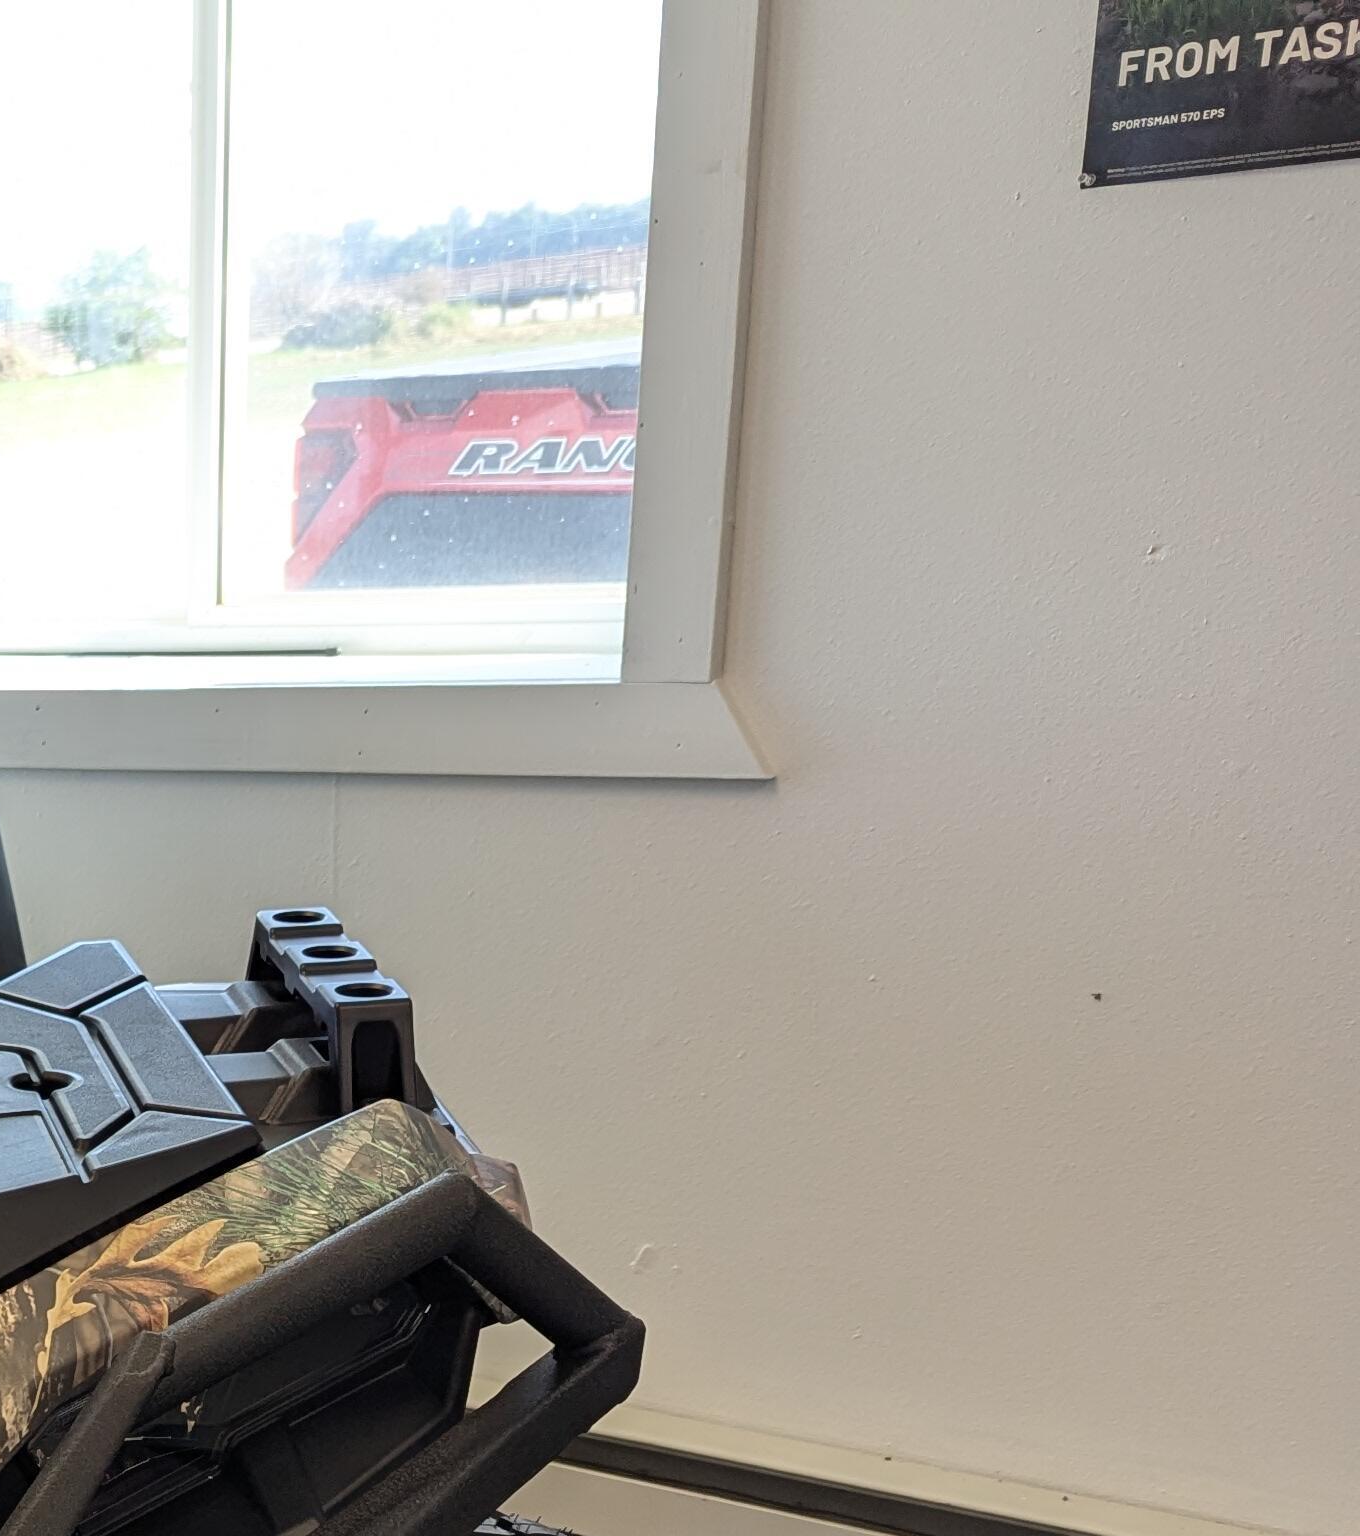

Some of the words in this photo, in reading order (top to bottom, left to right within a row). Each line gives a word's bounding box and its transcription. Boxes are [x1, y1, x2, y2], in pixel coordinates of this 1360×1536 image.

[1118, 35, 1240, 87] FROM
[1111, 113, 1178, 132] SPORTSMAN
[1180, 112, 1201, 124] 570
[1202, 107, 1226, 121] EPS
[449, 435, 636, 476] RAN
